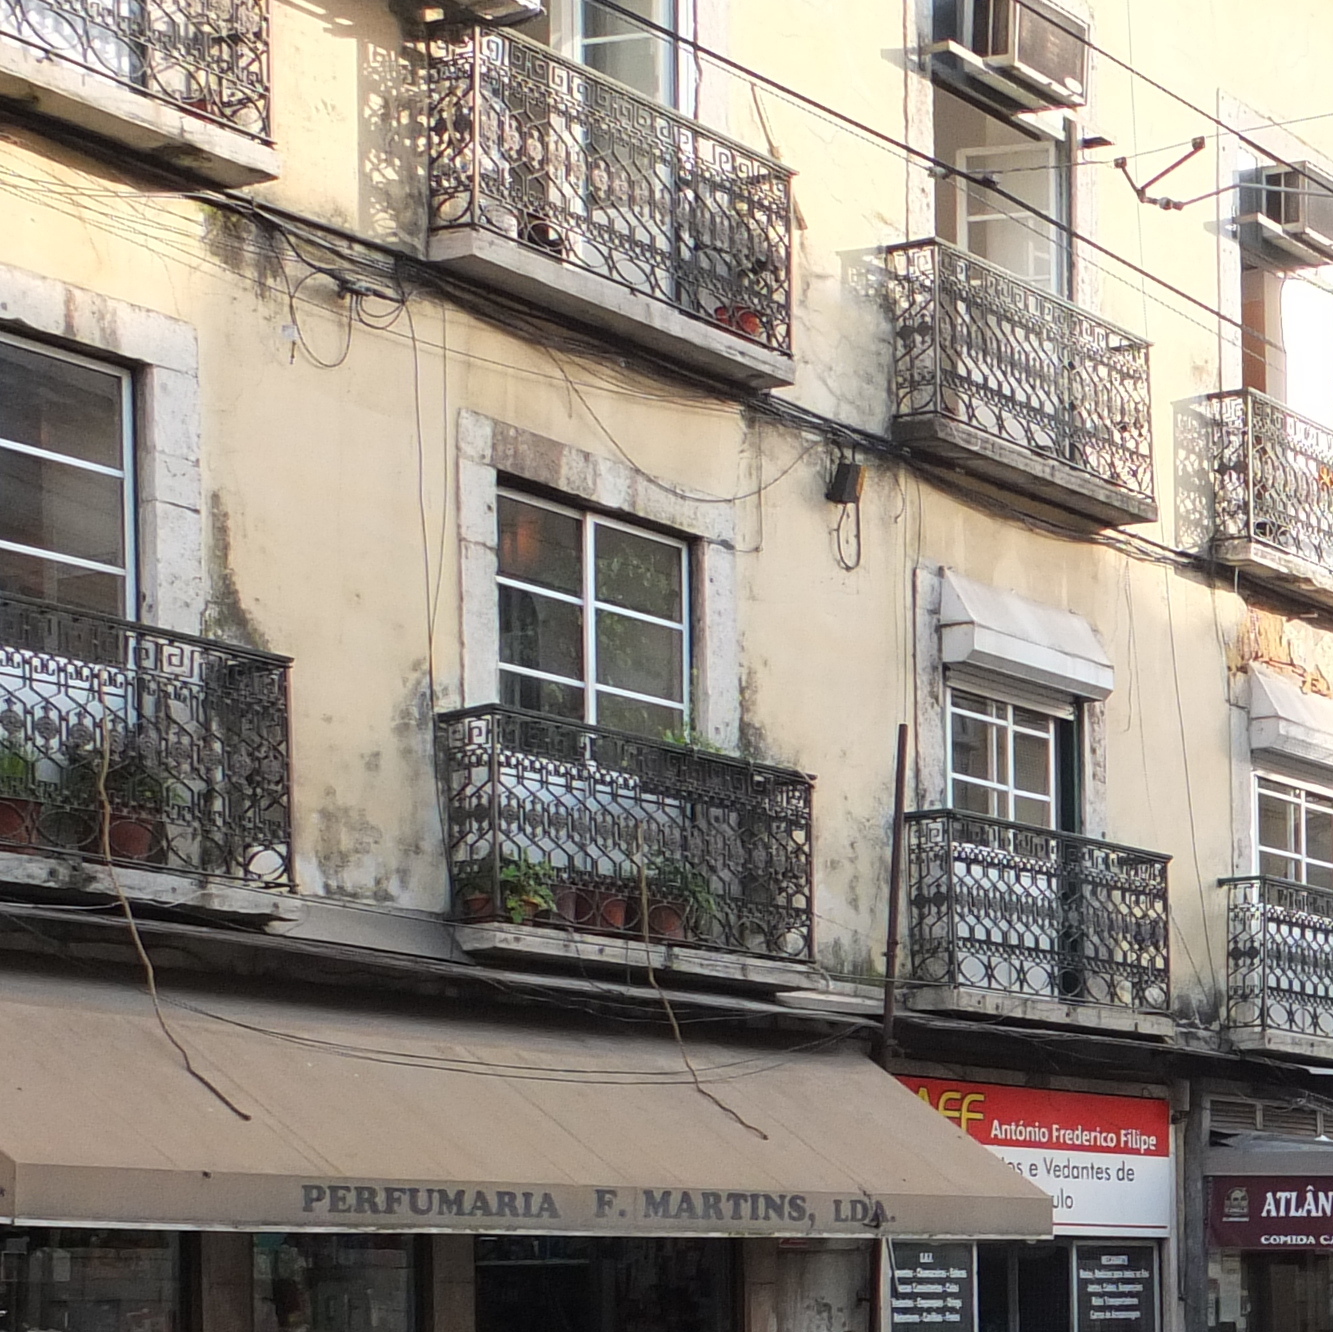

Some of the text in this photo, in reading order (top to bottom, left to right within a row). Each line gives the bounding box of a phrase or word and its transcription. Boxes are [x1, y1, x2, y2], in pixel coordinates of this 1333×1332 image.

[990, 1118, 1157, 1154] António Frederico Filipe
[1028, 1162, 1039, 1178] e
[1043, 1156, 1112, 1182] Vedantes
[1115, 1160, 1136, 1183] de
[301, 1184, 897, 1229] PERFUMARIA F. MARTINS, LDA.
[1260, 1234, 1316, 1246] COMIDA
